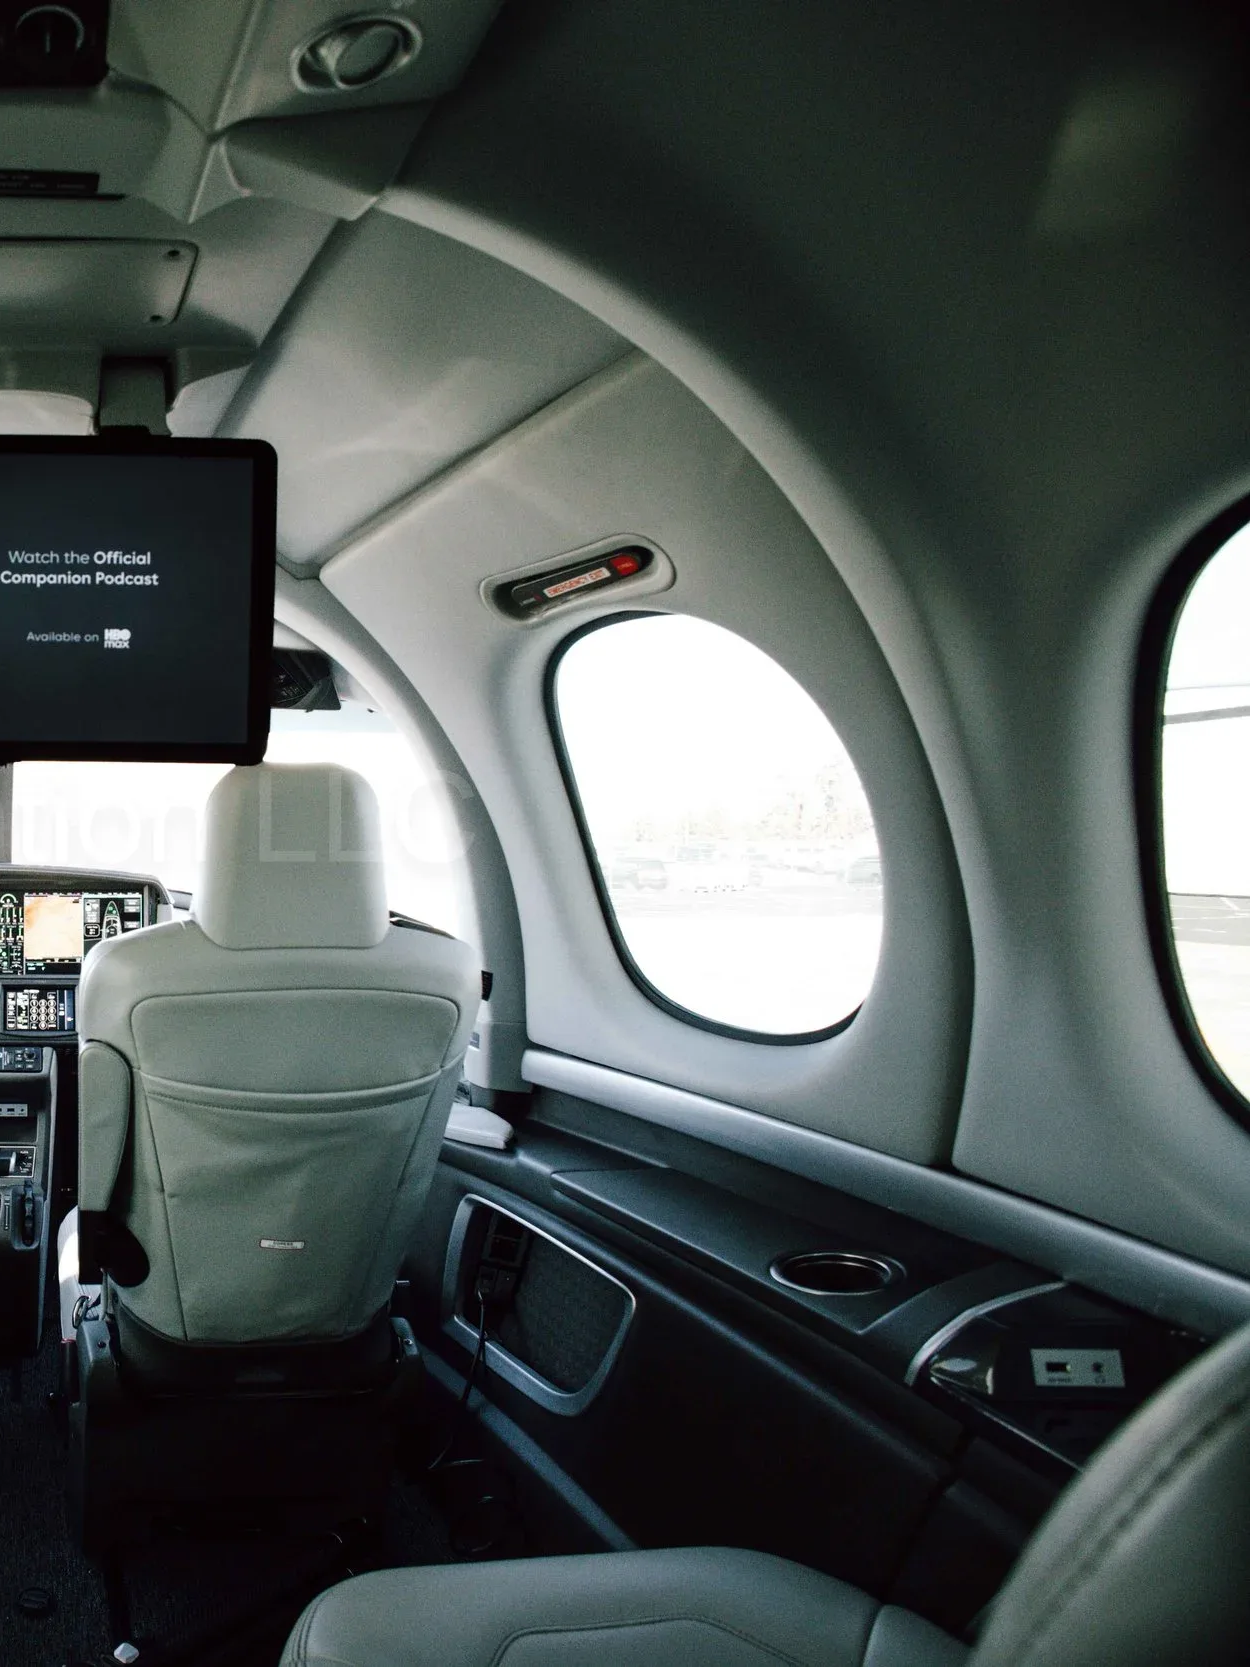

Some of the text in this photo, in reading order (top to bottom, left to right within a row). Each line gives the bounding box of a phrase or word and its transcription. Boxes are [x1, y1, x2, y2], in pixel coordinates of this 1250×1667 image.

[8, 550, 151, 565] Watch the Official
[0, 570, 159, 587] Companion Podcast
[26, 631, 100, 642] Available on
[104, 628, 132, 641] HBO
[104, 640, 130, 649] max
